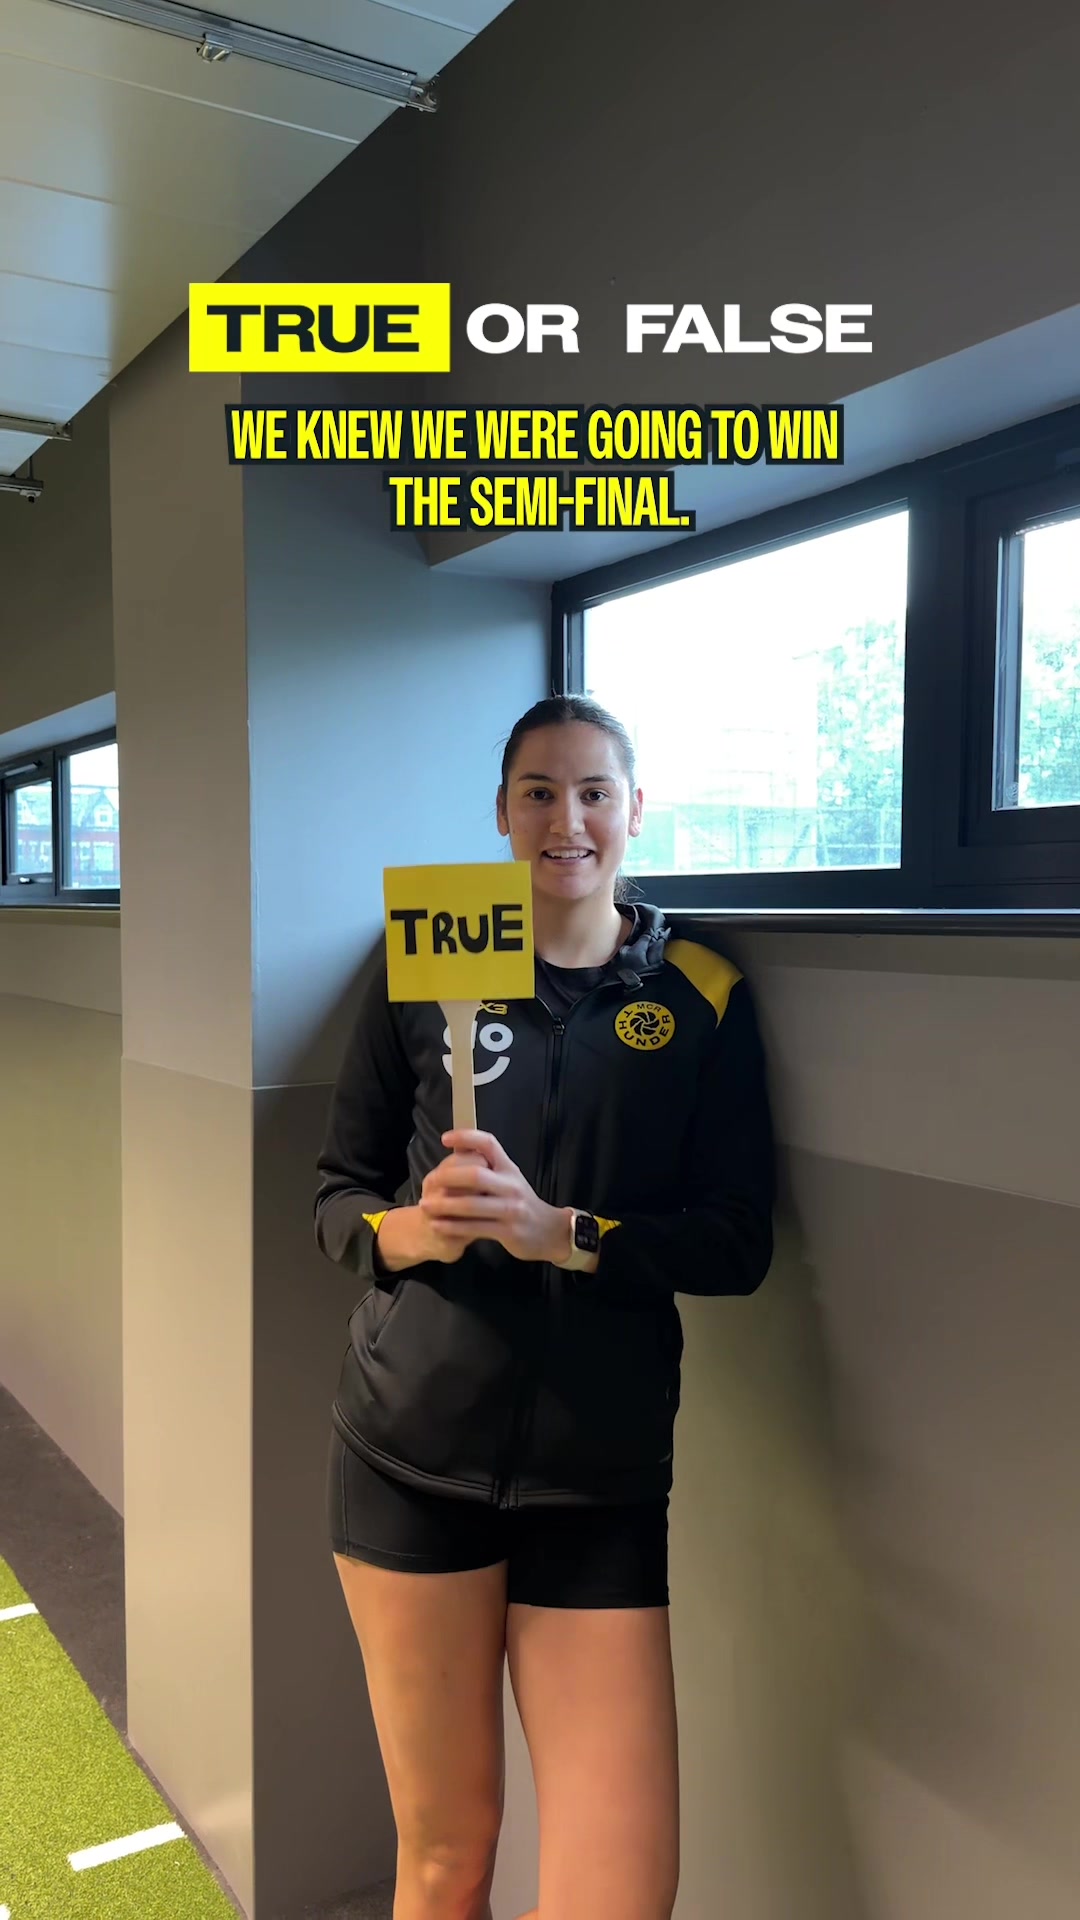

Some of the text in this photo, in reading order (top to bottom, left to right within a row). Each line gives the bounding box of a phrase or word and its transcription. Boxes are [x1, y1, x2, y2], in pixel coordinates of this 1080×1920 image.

[390, 903, 523, 955] TRUE
[637, 1003, 662, 1012] MCR
[618, 1010, 671, 1047] THUNDER
